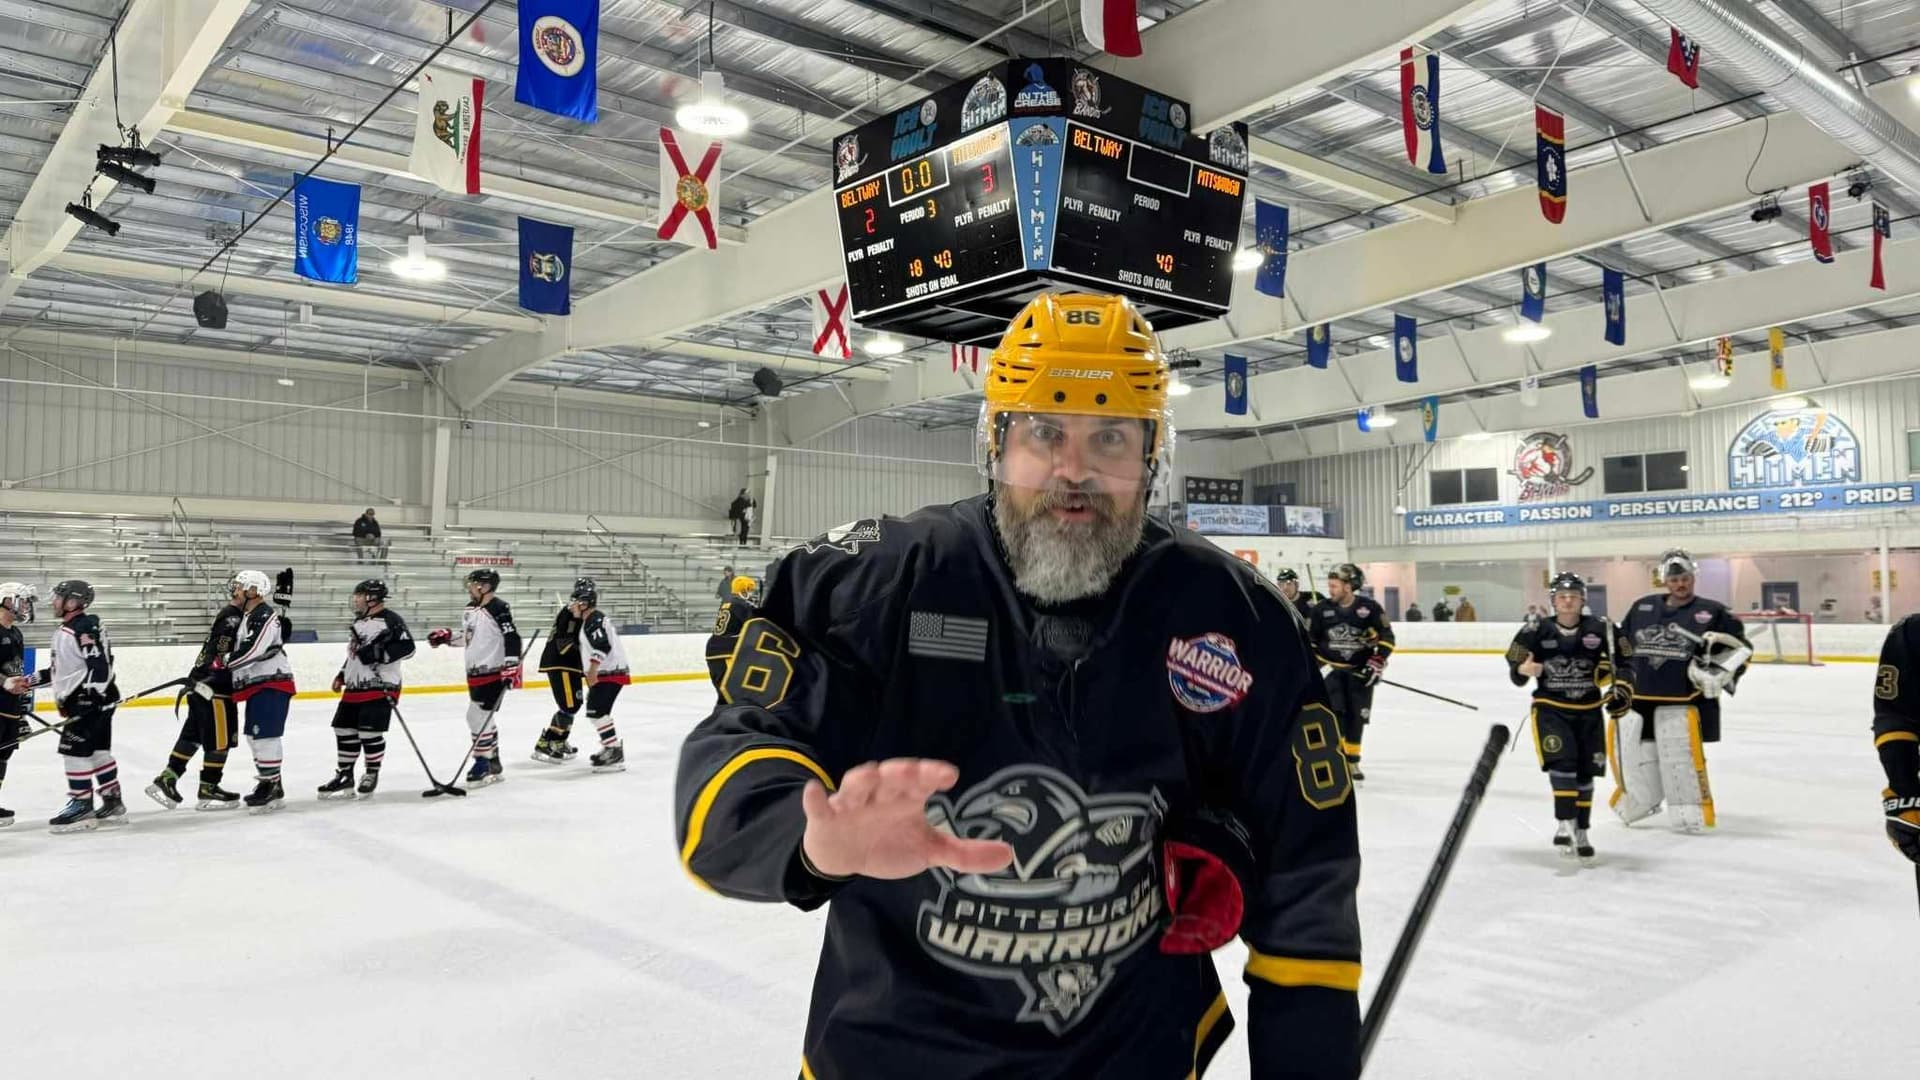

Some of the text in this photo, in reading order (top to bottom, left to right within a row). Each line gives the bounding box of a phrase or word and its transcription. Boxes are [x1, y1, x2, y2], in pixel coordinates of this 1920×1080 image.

[1013, 98, 1062, 108] CREASE
[1018, 91, 1057, 100] IN THE
[1073, 129, 1122, 159] BELTWAY
[981, 163, 994, 193] 3
[841, 180, 881, 208] BELTWAY
[1134, 194, 1160, 211] PERIOD
[864, 208, 876, 235] 2
[900, 206, 925, 224] PERIOD
[927, 199, 937, 218] 3
[954, 198, 1011, 228] PLYR PENALTY
[1063, 196, 1121, 222] PLYR PENALTY
[848, 238, 895, 263] PLYR PENALTY
[1183, 229, 1233, 252] PLYR PENALTY
[909, 250, 952, 278] 18 40
[1156, 253, 1174, 273] 40
[905, 274, 959, 298] SHOTS ON GOAL
[1118, 269, 1173, 292] SHOTS ON GOAL
[1066, 310, 1100, 325] 86
[1048, 369, 1114, 380] BAUER
[1731, 448, 1858, 486] HITMEN
[1413, 487, 1913, 527] CHARACTER PASSION PERSEVERANCE 212° PRIDE
[720, 617, 801, 710] 6
[1168, 637, 1253, 694] WARRIOR
[1875, 664, 1900, 700] 3
[1292, 703, 1352, 810] 8
[955, 873, 1150, 931] PITTSBURGH
